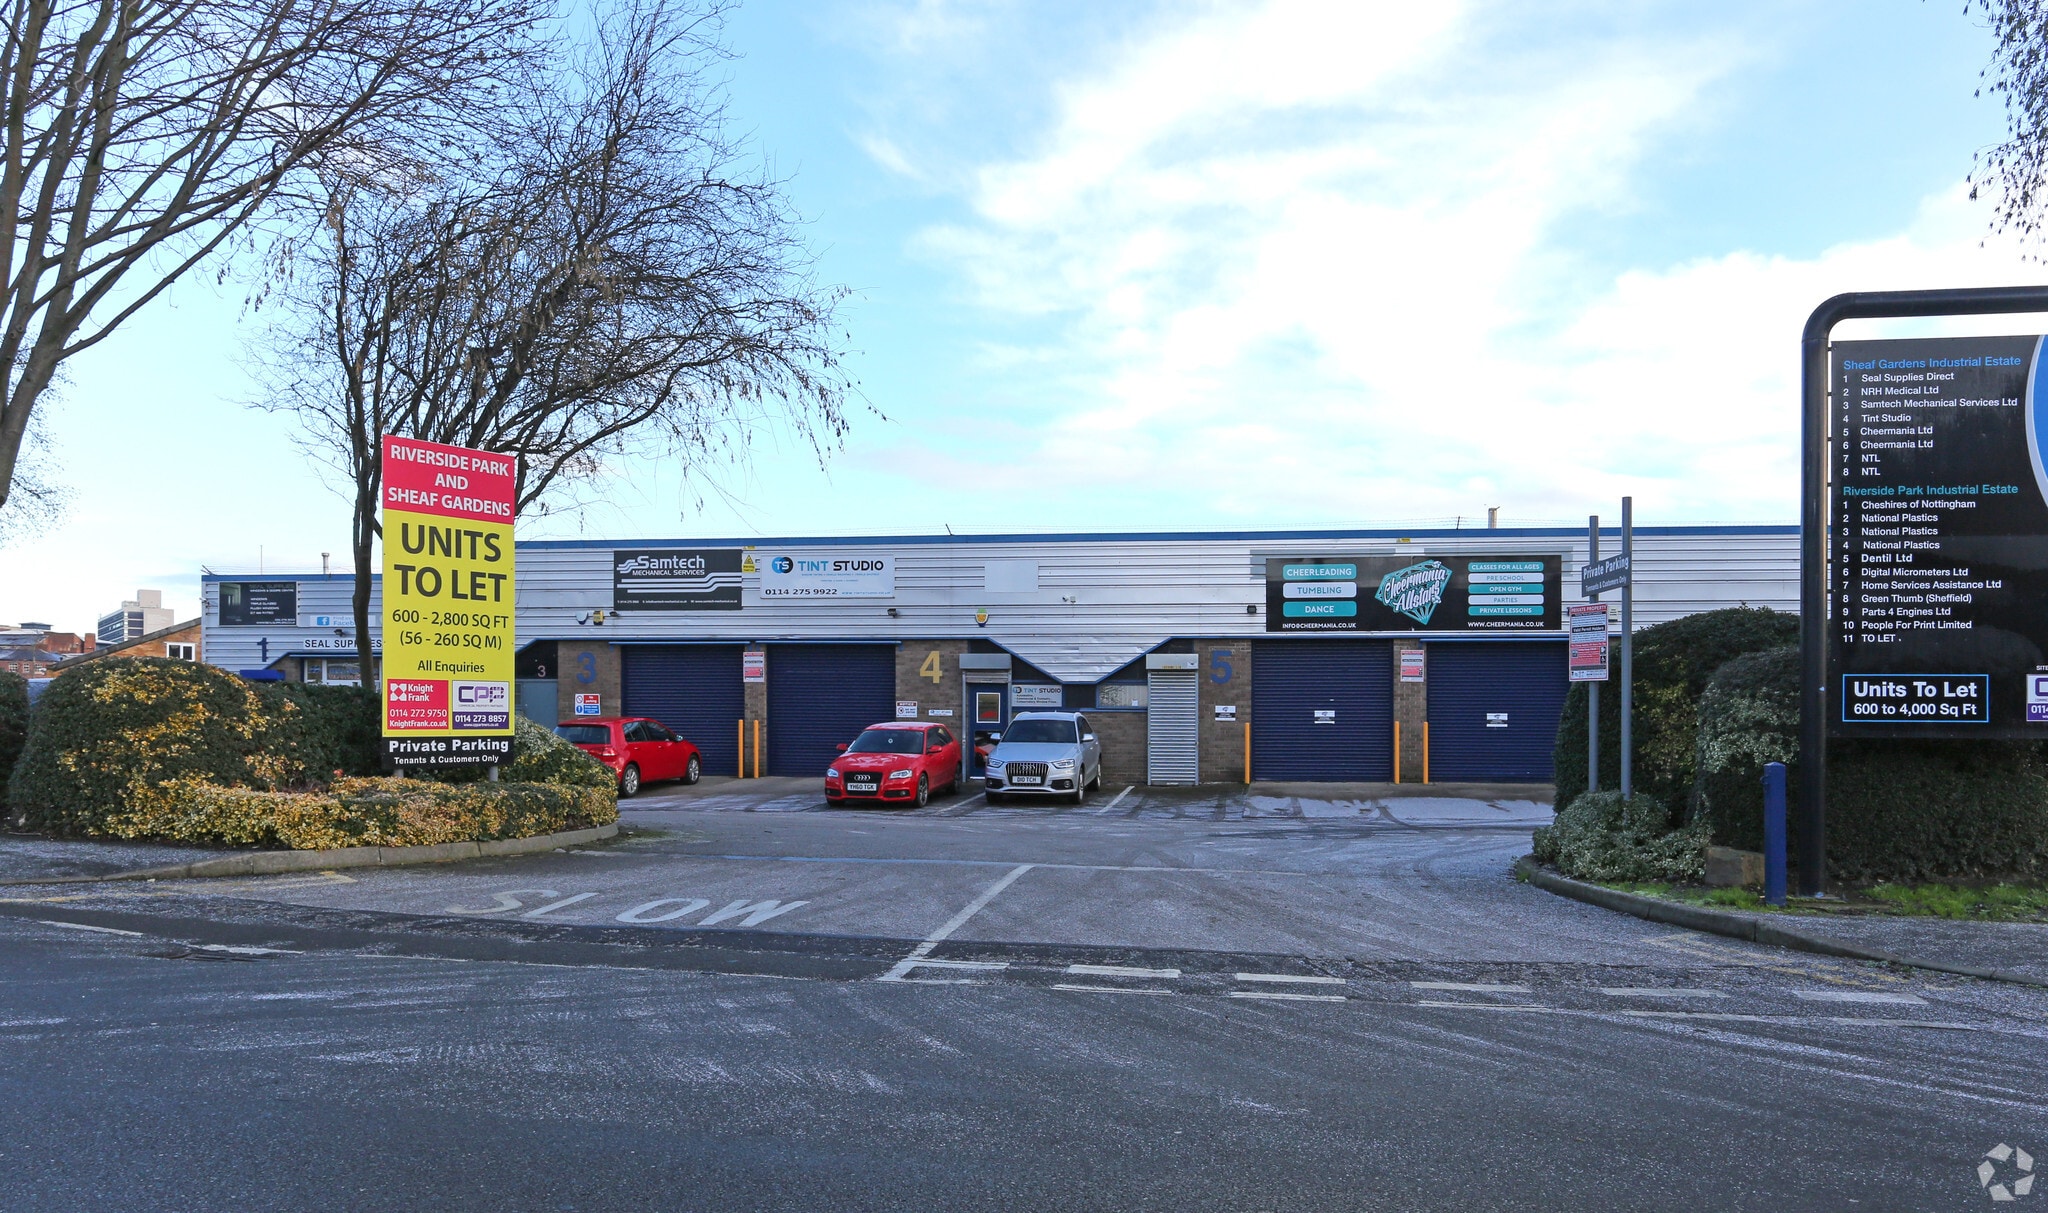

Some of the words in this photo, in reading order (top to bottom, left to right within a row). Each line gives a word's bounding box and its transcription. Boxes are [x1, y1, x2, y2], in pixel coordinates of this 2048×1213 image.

[1844, 360, 1876, 370] Sheaf
[1879, 359, 1926, 369] Gardens
[1929, 357, 1981, 368] Industrial
[1985, 356, 2021, 367] Estate
[1861, 374, 1882, 382] Seal
[1884, 373, 1924, 383] Supplies
[1926, 372, 1954, 381] Direct
[1861, 388, 1882, 396] NRH
[1885, 386, 1921, 395] Medical
[1923, 386, 1938, 394] Ltd
[1861, 400, 1901, 409] Samtech
[1904, 399, 1957, 408] Mechanical
[1959, 399, 1999, 407] Services
[2002, 398, 2018, 406] Ltd
[1861, 414, 1879, 422] Tint
[1881, 414, 1911, 422] Studio
[1860, 427, 1915, 435] Cheermania
[1918, 426, 1933, 434] Ltd
[1860, 440, 1916, 449] Cheermania
[1918, 440, 1933, 448] Ltd
[391, 444, 469, 471] RIVERSIDE
[472, 458, 509, 476] PARK
[1861, 454, 1880, 462] NTL
[1861, 468, 1880, 476] NTL
[434, 473, 468, 490] AND
[1843, 486, 1894, 496] Riverside
[1898, 486, 1923, 495] Park
[1927, 485, 1978, 494] Industrial
[1982, 485, 2018, 494] Estate
[388, 487, 438, 507] SHEAF
[442, 495, 511, 517] GARDENS
[1861, 500, 1907, 509] Cheshires
[1910, 500, 1919, 509] of
[1921, 500, 1976, 510] Nottingham
[1861, 514, 1900, 522] National
[1902, 514, 1938, 522] Plastics
[1861, 527, 1900, 536] National
[1902, 527, 1938, 535] Plastics
[402, 522, 501, 562] UNITS
[1863, 541, 1901, 549] National
[1904, 541, 1940, 549] Plastics
[637, 555, 704, 569] Samtech
[1861, 554, 1891, 562] Dentil
[1896, 554, 1912, 562] Ltd
[775, 561, 790, 570] TS
[798, 561, 829, 571] TINT
[833, 560, 884, 571] STUDIO
[1583, 564, 1604, 580] Private
[1606, 557, 1629, 573] Parking
[1287, 567, 1352, 576] CHEERLEADING
[1861, 567, 1890, 578] Digital
[1893, 568, 1951, 576] Micrometers
[1953, 568, 1968, 576] Ltd
[394, 564, 442, 597] TO
[452, 569, 507, 602] LET
[1384, 569, 1445, 604] Cheermania
[1861, 581, 1889, 589] Home
[1891, 581, 1930, 589] Services
[1932, 580, 1983, 589] Assistance
[1986, 580, 2001, 588] Ltd
[1297, 586, 1342, 595] TUMBLING
[1393, 580, 1440, 611] Allstars
[1861, 594, 1889, 603] Green
[1891, 594, 1924, 603] Thumb
[1926, 594, 1972, 604] (Sheffield)
[1305, 605, 1334, 613] DANCE
[1862, 608, 1886, 616] Parts
[1888, 608, 1894, 616] 4
[1896, 608, 1933, 617] Engines
[1936, 607, 1951, 616] Ltd
[392, 609, 419, 623] 600
[431, 612, 468, 627] 2,800
[472, 614, 490, 629] SQ
[494, 615, 509, 629] FT
[1861, 621, 1893, 631] People
[1896, 621, 1910, 629] For
[1913, 621, 1935, 629] Print
[1938, 621, 1972, 629] Limited
[334, 639, 382, 648] SUPES
[400, 631, 422, 646] (56
[434, 632, 460, 647] 260
[463, 634, 481, 649] SQ
[485, 635, 502, 650] M)
[1861, 634, 1875, 642] TO
[1878, 634, 1896, 642] LET
[256, 637, 269, 662] 1
[305, 640, 330, 648] SEAL
[417, 660, 432, 671] All
[435, 661, 485, 674] Enquiries
[537, 665, 546, 678] 3
[576, 652, 597, 684] 3
[920, 651, 943, 684] 4
[1209, 650, 1233, 684] 5
[408, 684, 433, 694] Knight
[1854, 681, 1907, 698] Units
[1913, 681, 1937, 698] To
[1944, 681, 1977, 698] Let
[408, 694, 429, 702] Frank
[389, 709, 408, 717] 0114
[410, 709, 425, 717] 272
[427, 709, 447, 717] 9750
[1853, 703, 1878, 715] 600
[1881, 704, 1896, 715] to
[1899, 703, 1936, 716] 4,000
[1940, 703, 1959, 717] Sq
[1962, 703, 1977, 715] Ft
[389, 720, 447, 728] KnightFrank.co.uk
[389, 740, 447, 752] Private
[452, 739, 509, 752] Parking
[394, 757, 427, 765] Tenants
[482, 754, 499, 763] Only
[445, 889, 812, 927] SLOW
